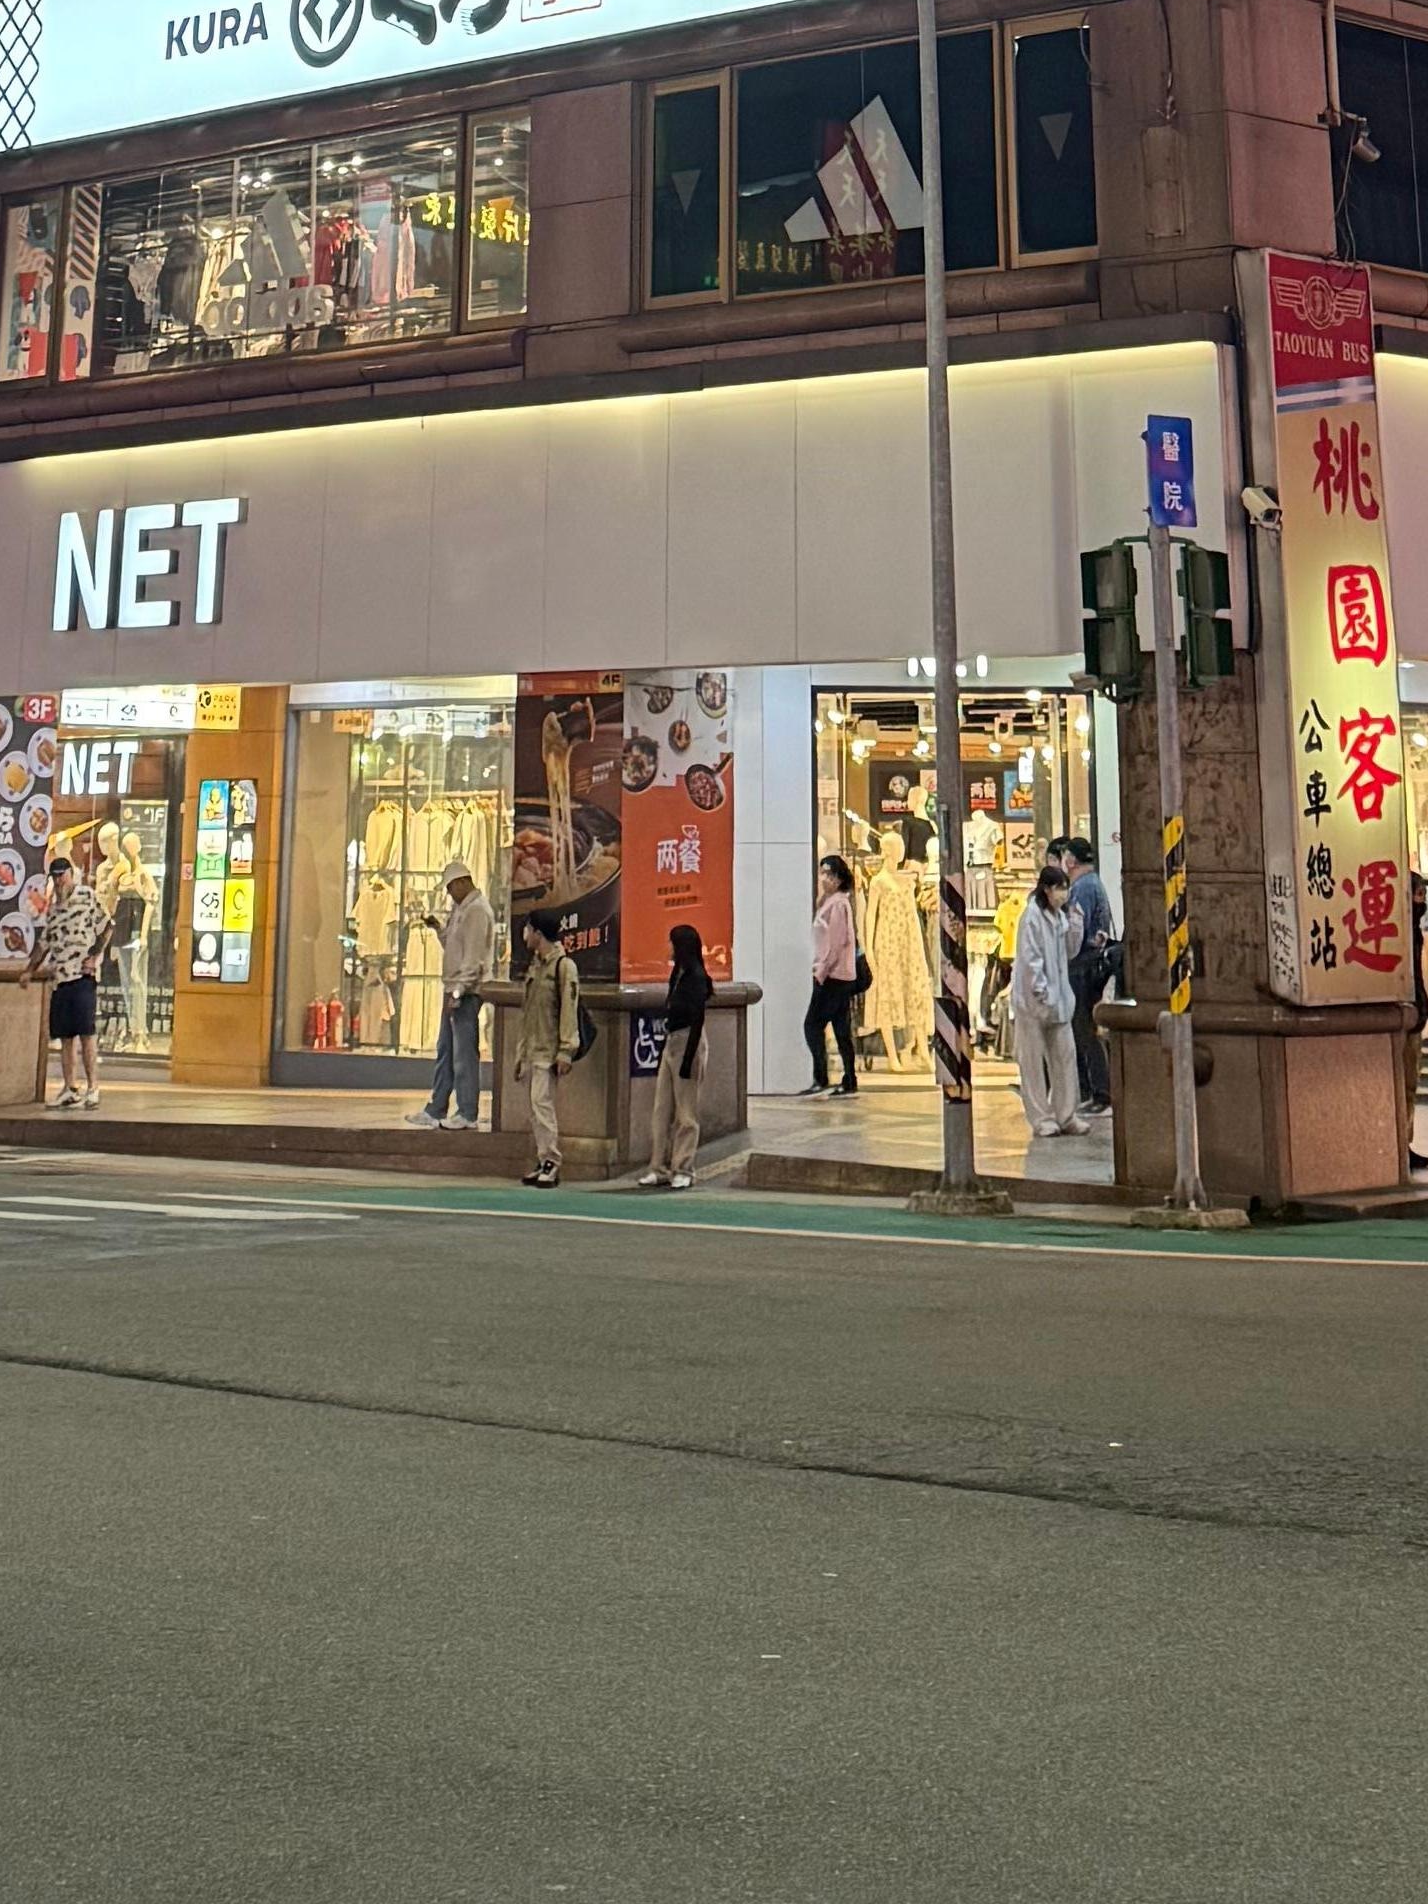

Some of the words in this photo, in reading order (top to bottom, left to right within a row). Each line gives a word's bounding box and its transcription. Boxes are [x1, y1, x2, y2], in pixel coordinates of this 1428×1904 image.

[164, 0, 269, 61] KURA
[1274, 331, 1335, 359] TAOYUAN
[1342, 340, 1370, 365] BUS
[51, 496, 241, 632] NET
[26, 697, 53, 720] 3F
[1310, 415, 1403, 975] 桃園客運
[60, 740, 139, 796] NET
[1299, 696, 1338, 972] 公車總站
